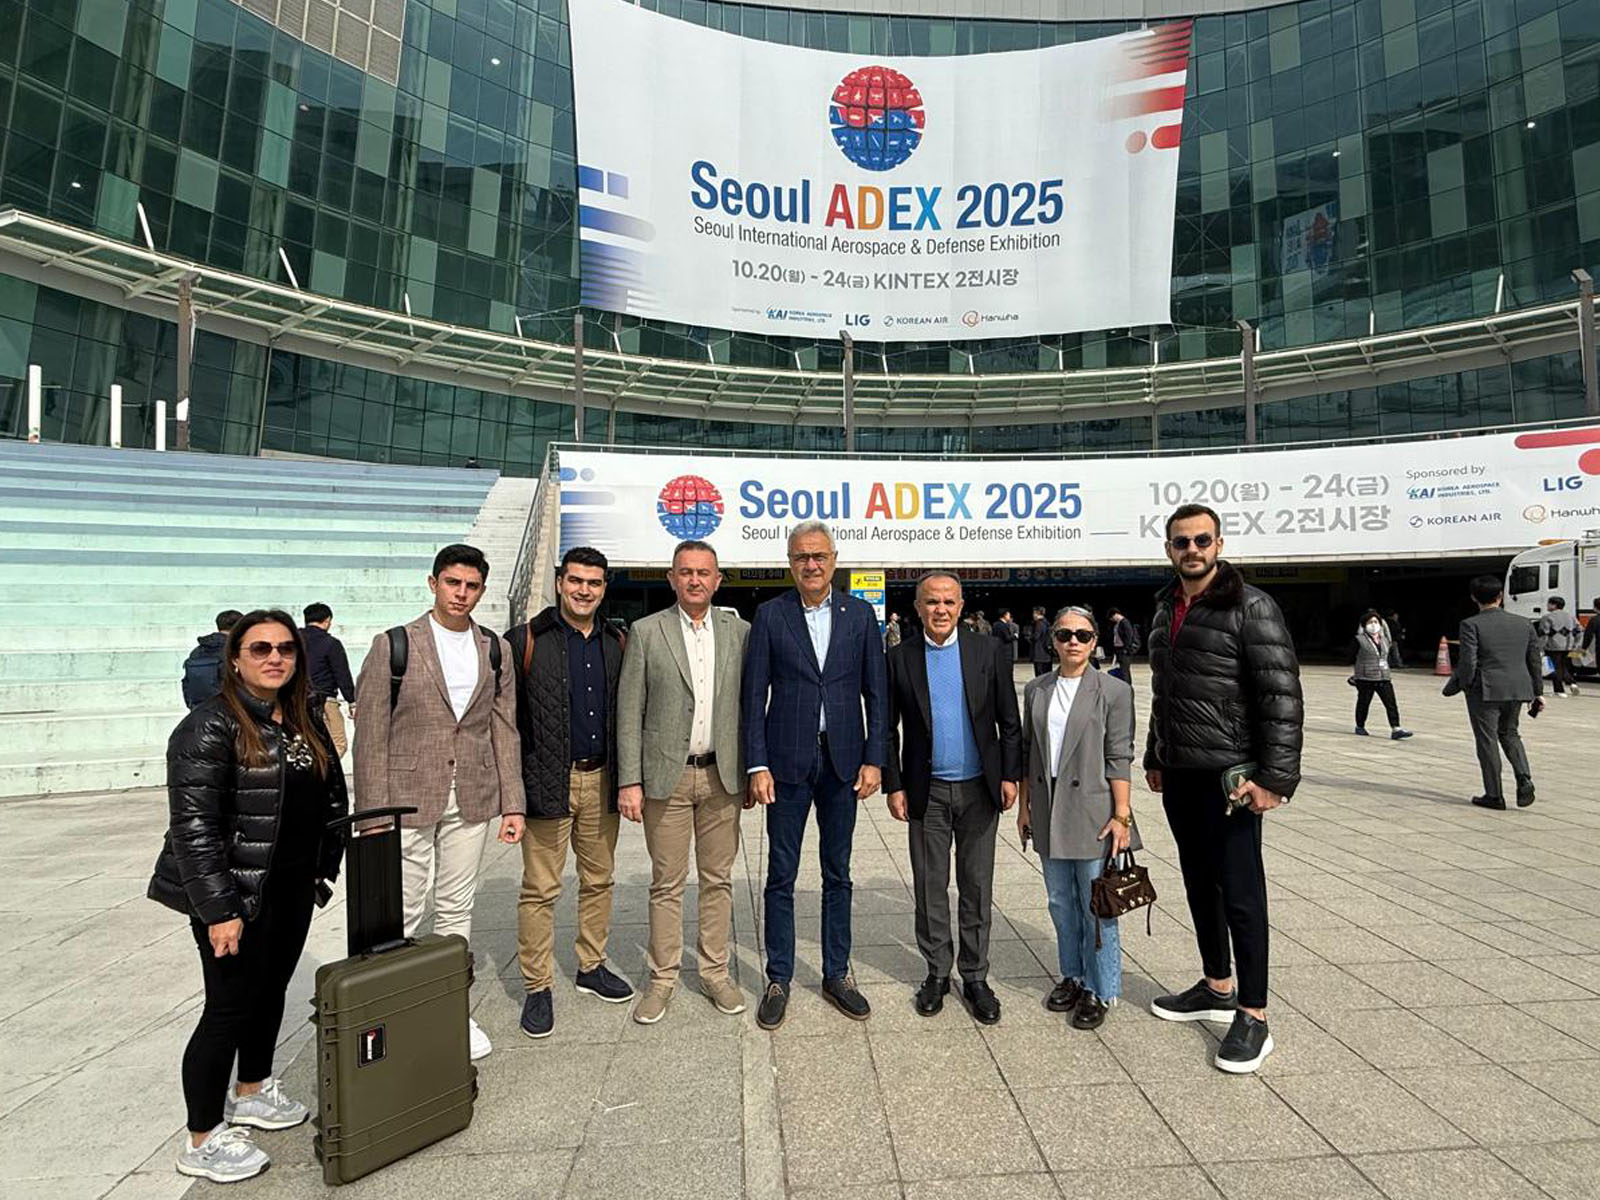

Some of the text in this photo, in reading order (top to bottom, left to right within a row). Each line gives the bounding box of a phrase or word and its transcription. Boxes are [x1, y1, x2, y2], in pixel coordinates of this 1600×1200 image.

[691, 160, 1063, 231] Seoul ADEX 2025
[694, 215, 1061, 258] Seoul International Aerospace & Defense Exhibition
[732, 259, 806, 284] 10.20(월)
[823, 269, 870, 289] 24(금)
[874, 271, 950, 290] KINTEX
[955, 268, 1019, 289] 2전시장
[765, 307, 788, 320] KAI
[845, 314, 871, 327] LIG
[896, 316, 932, 325] KOREAN
[934, 316, 949, 325] AIR
[1406, 466, 1485, 480] Sponsored by
[1543, 475, 1583, 492] LIG
[739, 480, 1082, 520] Seoul ADEX 2025
[1149, 479, 1269, 505] 10.20(월)
[1302, 473, 1390, 499] 24(금)
[1407, 485, 1436, 500] KAI
[1139, 504, 1391, 538] KEX 2전시장
[1427, 512, 1502, 525] KOREAN AIR
[741, 525, 780, 540] Seoul
[870, 526, 941, 543] Aerospace
[944, 526, 955, 541] &
[959, 526, 1013, 540] Defense
[1017, 525, 1081, 540] Exhibition
